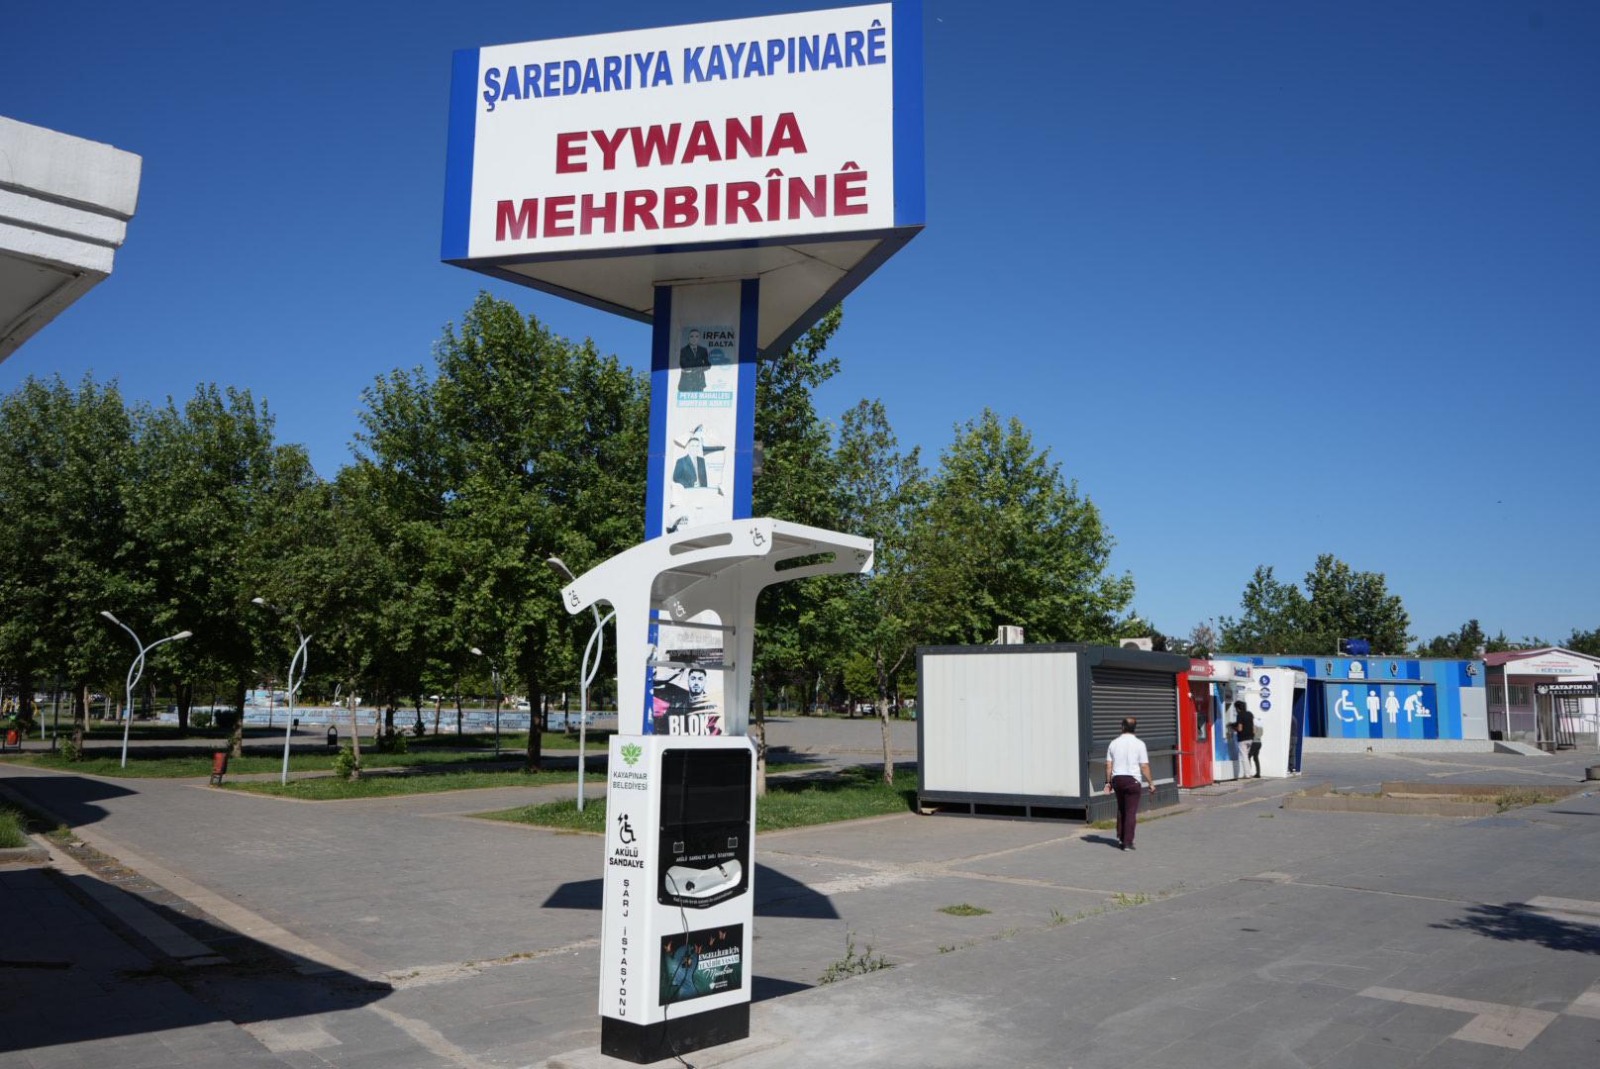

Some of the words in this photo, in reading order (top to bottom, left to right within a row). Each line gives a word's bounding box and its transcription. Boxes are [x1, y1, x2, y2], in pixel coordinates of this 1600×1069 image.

[484, 50, 673, 112] ŞAREDARIYA
[684, 19, 886, 84] KAYAPINARÊ
[555, 112, 807, 174] EYWANA
[495, 161, 869, 242] MEHRBIRÎNÊ
[613, 771, 648, 780] KAYAPINAR
[612, 781, 648, 790] BELEDİYESİ
[615, 846, 639, 857] AKÜLÜ
[609, 857, 644, 868] SANDALYE
